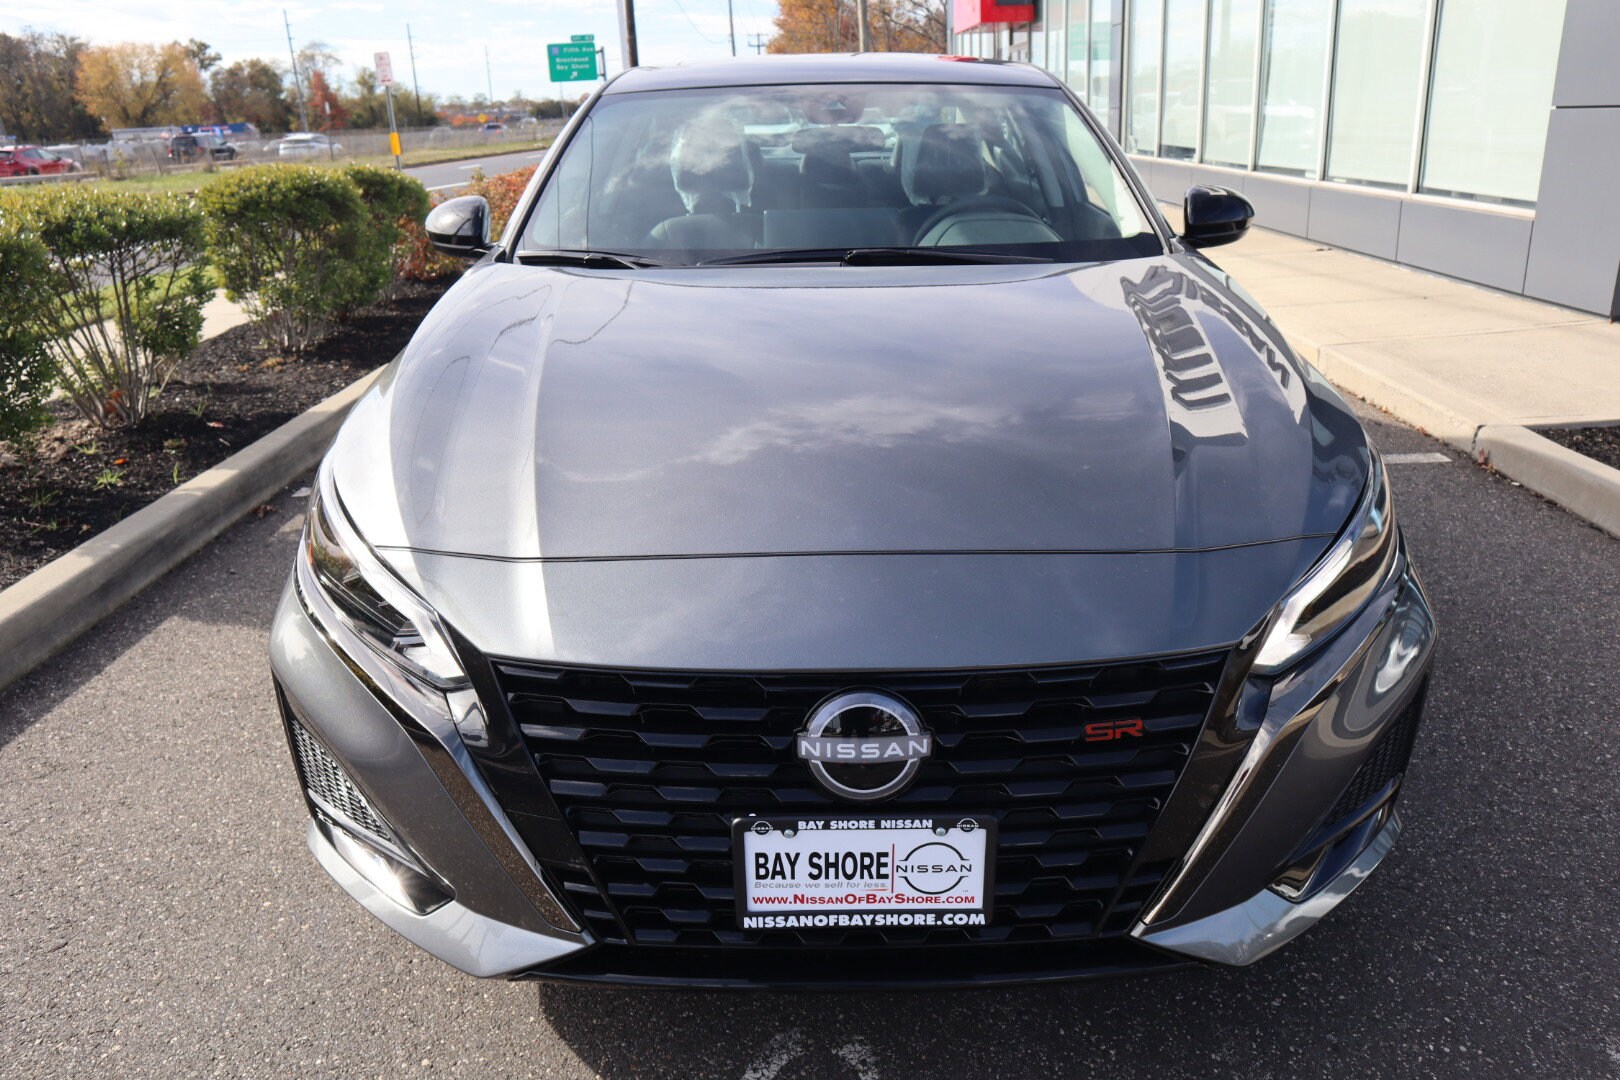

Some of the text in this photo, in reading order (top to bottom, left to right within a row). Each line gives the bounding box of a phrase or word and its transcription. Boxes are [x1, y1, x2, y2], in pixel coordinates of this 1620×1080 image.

[1084, 719, 1143, 742] SR
[800, 738, 928, 759] NISSAN
[797, 819, 933, 830] BAY SHORE NISSAN
[754, 851, 889, 881] BAY SHORE
[896, 864, 972, 873] NISSAN
[754, 881, 801, 889] Because
[824, 881, 843, 889] sell
[846, 881, 860, 889] for
[743, 913, 986, 929] NISSANOFBAYSHORE.COM
